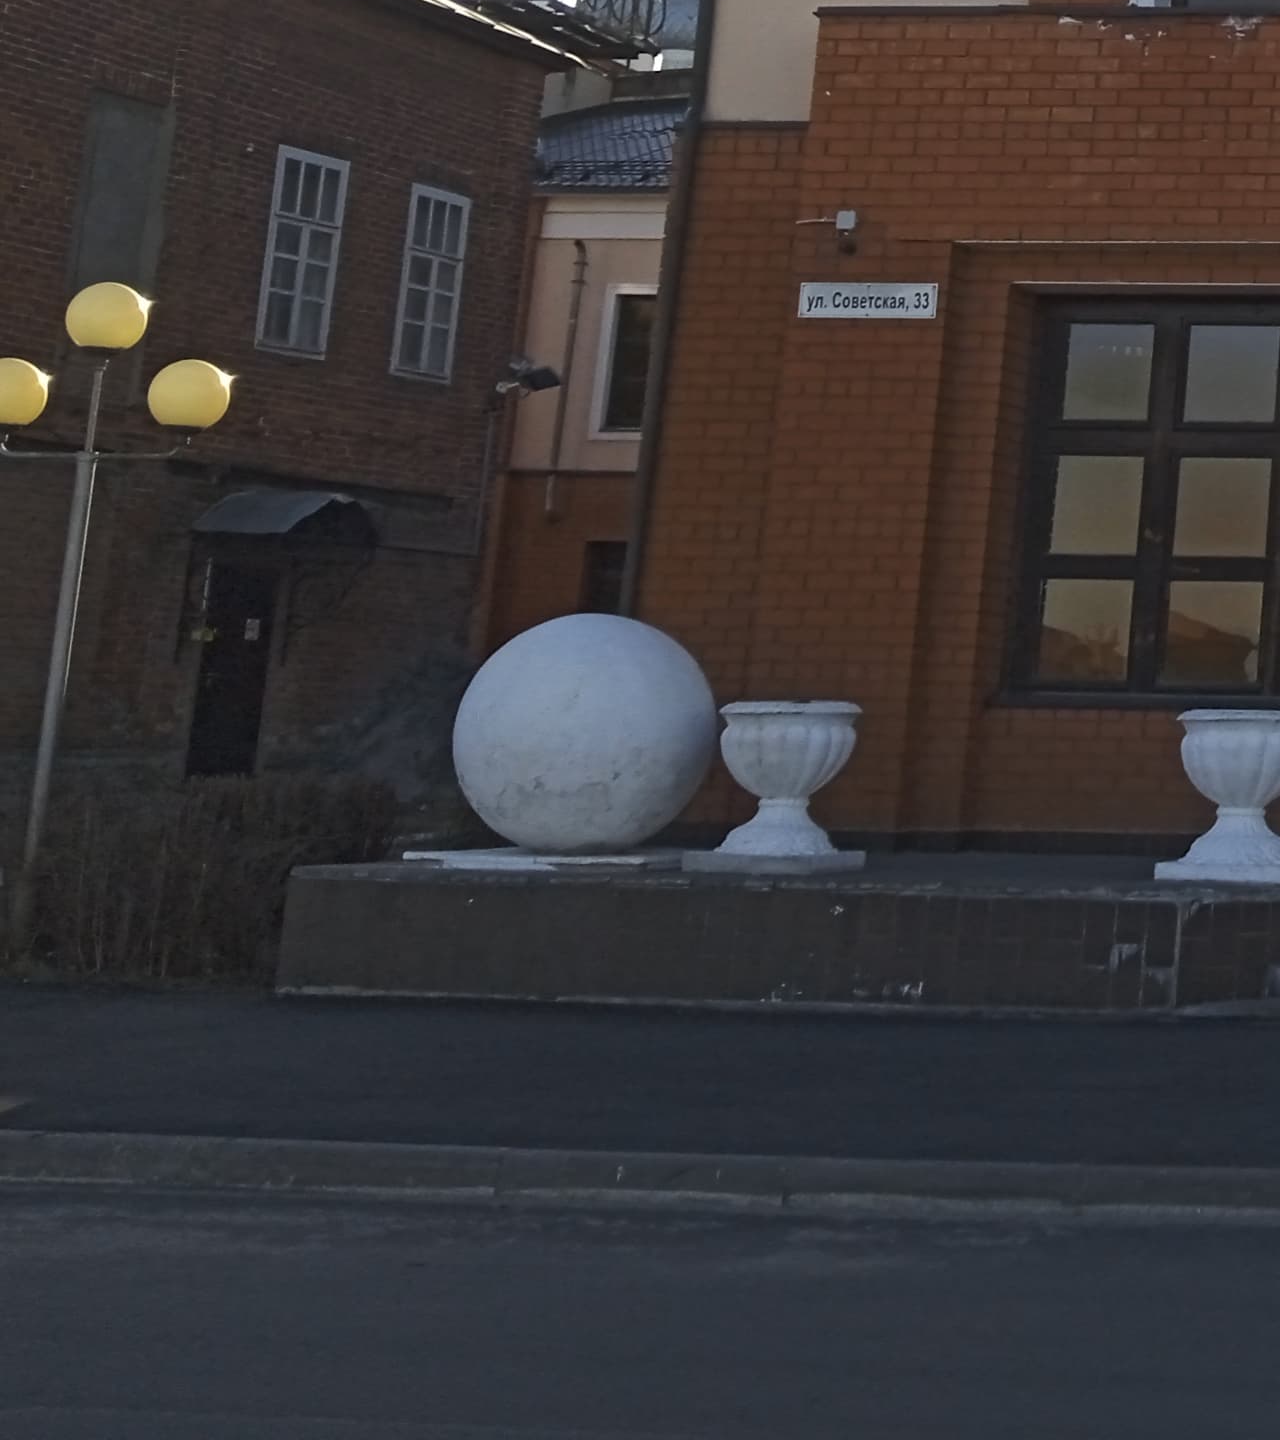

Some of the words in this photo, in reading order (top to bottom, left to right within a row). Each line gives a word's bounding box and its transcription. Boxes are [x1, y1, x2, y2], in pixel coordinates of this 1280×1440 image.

[807, 295, 828, 312] ул.
[832, 292, 909, 311] Советская,
[913, 293, 930, 309] 33
